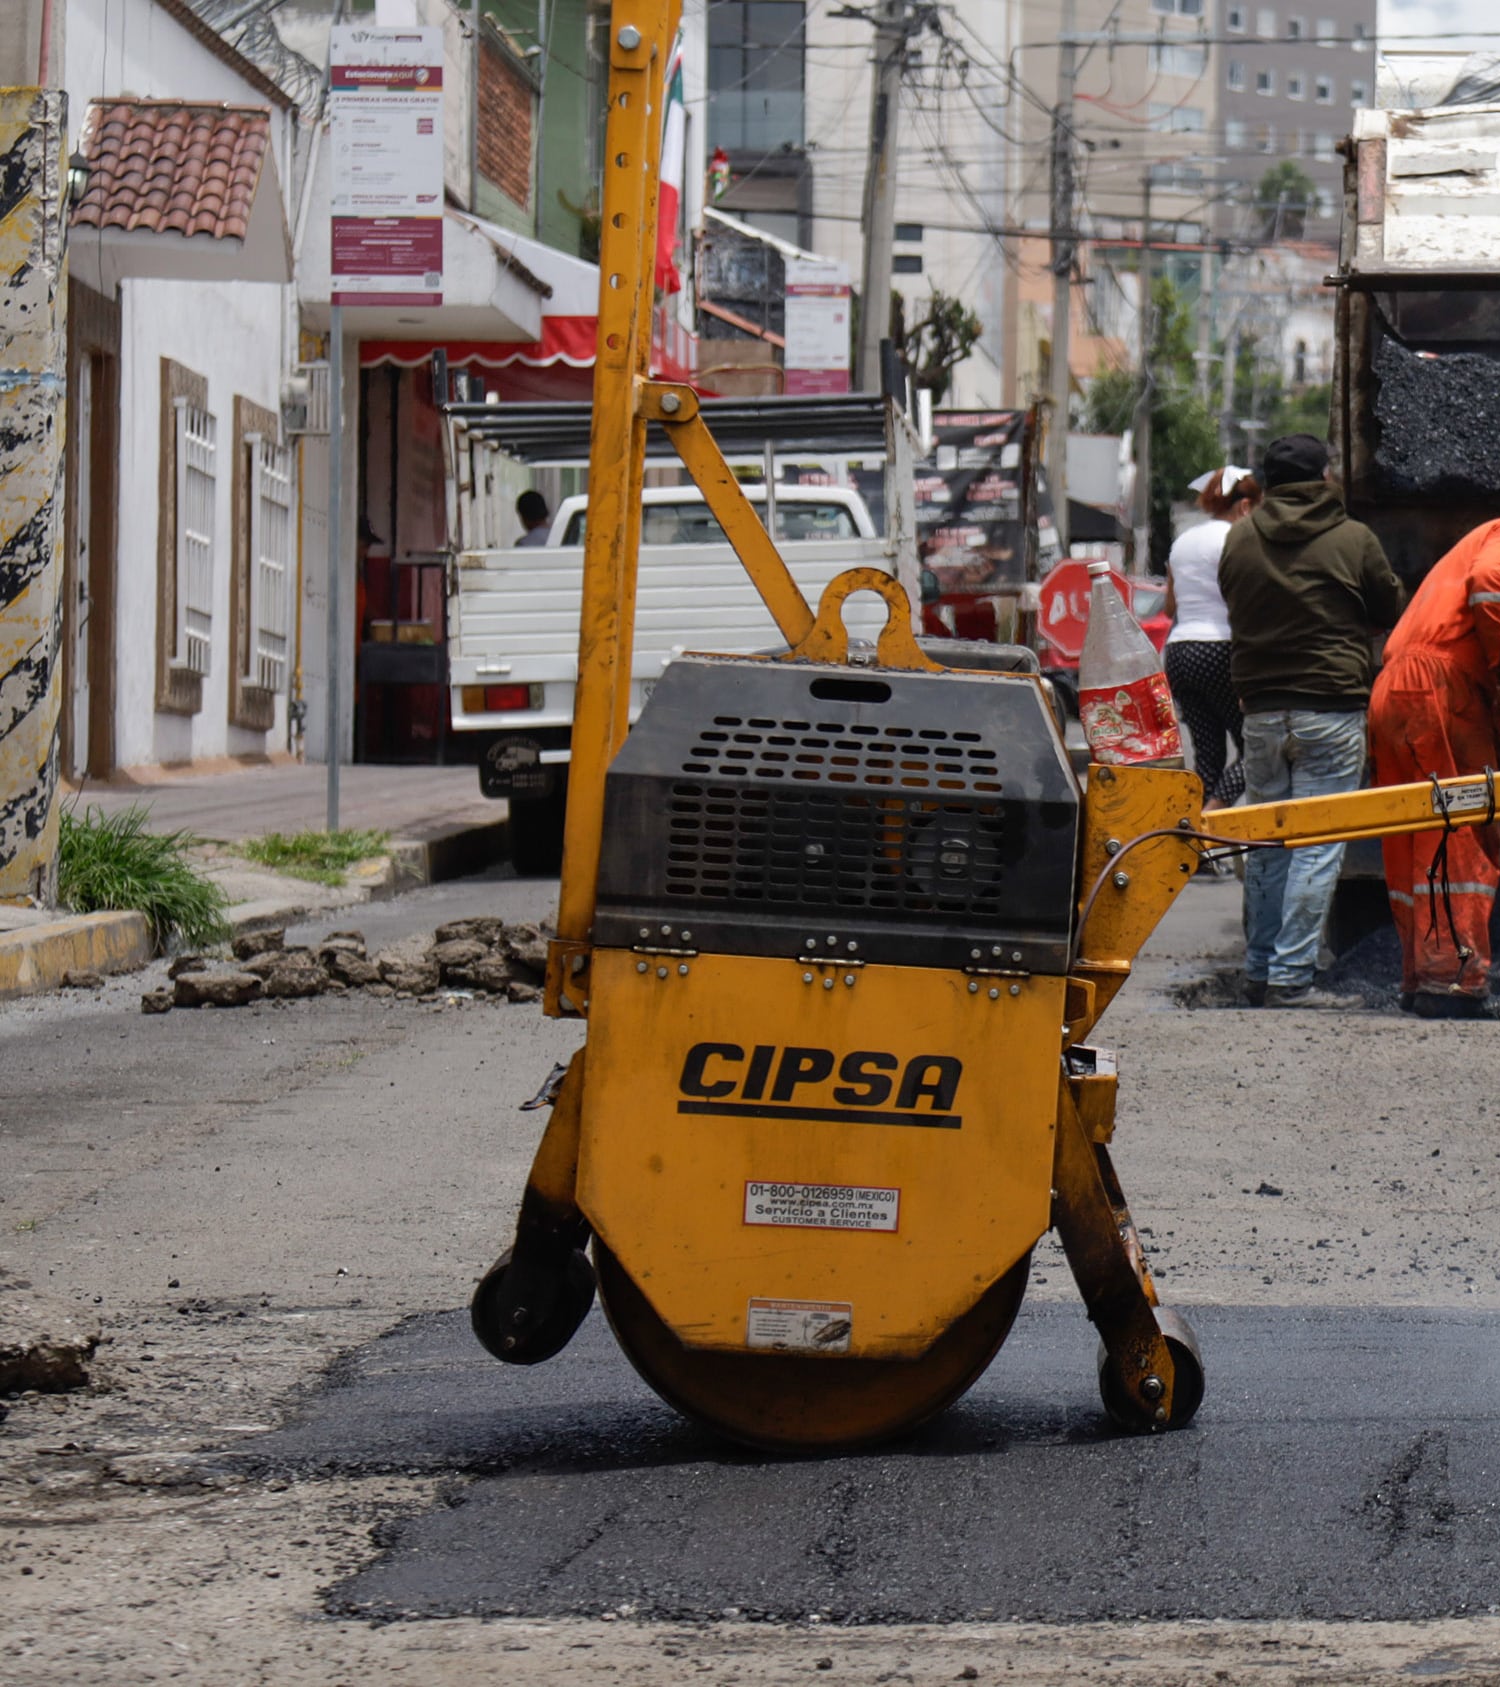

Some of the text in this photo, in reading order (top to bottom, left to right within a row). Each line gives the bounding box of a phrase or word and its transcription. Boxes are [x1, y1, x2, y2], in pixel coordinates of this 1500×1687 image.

[679, 1042, 963, 1111] CIPSA
[750, 1184, 895, 1203] 01-800-0126959 (MEXICO)
[755, 1204, 888, 1221] Servicio a Clientes
[770, 1199, 873, 1209] www.cipsa.com.mx
[771, 1216, 872, 1228] CUSTOMER SERVICE
